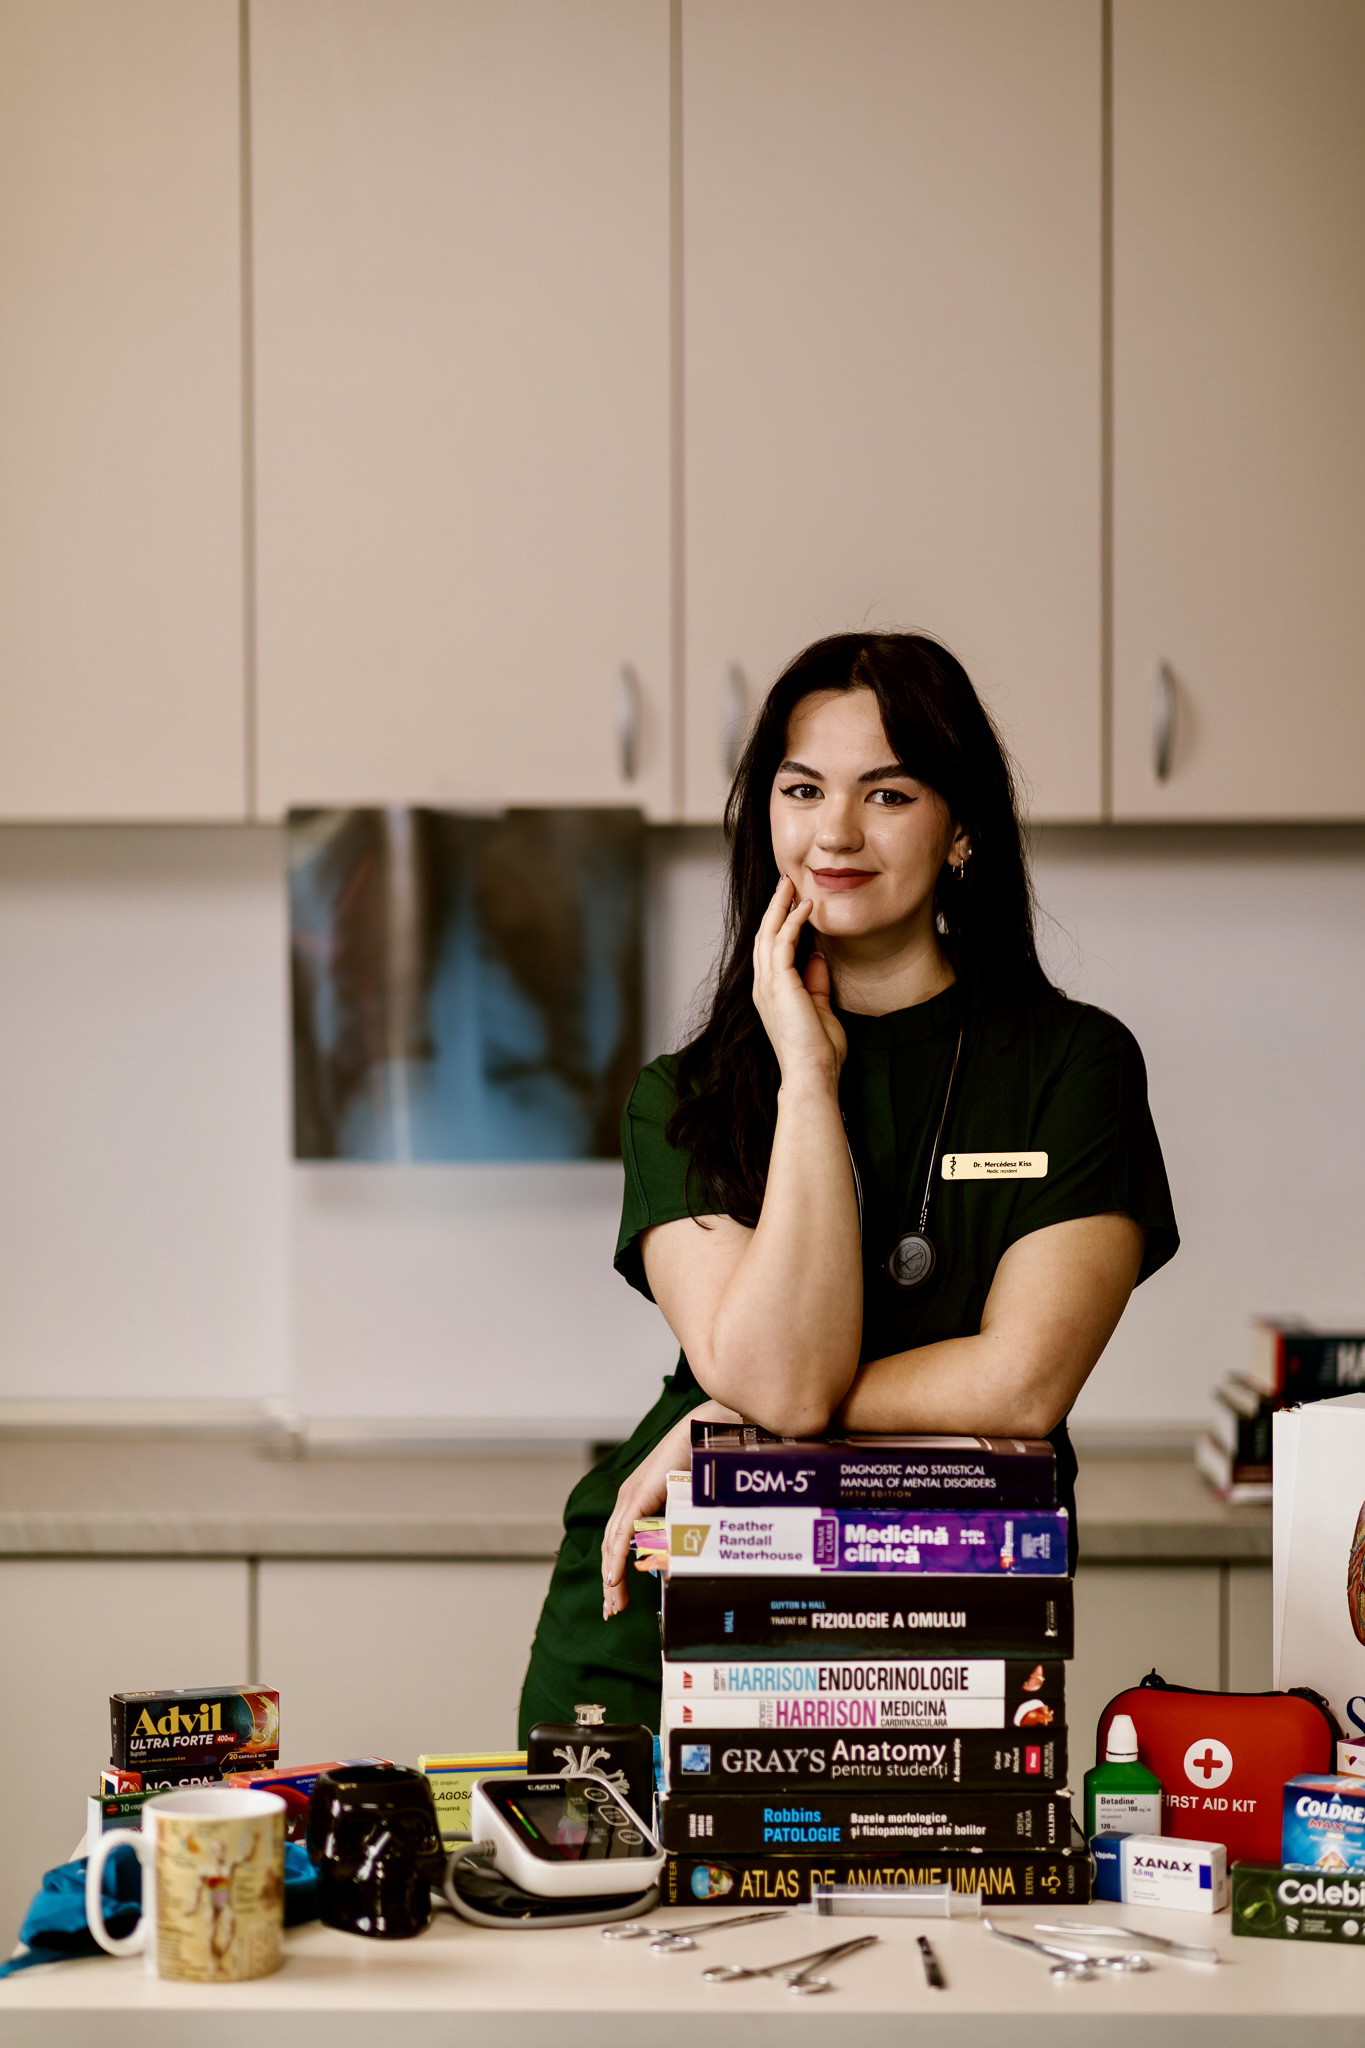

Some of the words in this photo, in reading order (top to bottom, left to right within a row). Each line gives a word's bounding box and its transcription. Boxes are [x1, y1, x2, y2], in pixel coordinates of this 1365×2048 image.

[840, 1464, 902, 1475] DIAGNOSTIC
[905, 1464, 929, 1475] AND
[930, 1464, 986, 1475] STATISTICAL
[840, 1477, 884, 1489] MANUAL
[886, 1477, 901, 1488] OF
[903, 1477, 942, 1488] MENTAL
[944, 1477, 997, 1489] DISORDERS
[840, 1490, 867, 1498] FIFTH
[871, 1490, 912, 1498] EDITION
[719, 1520, 774, 1532] Feather
[719, 1534, 772, 1546] Randall
[844, 1524, 949, 1546] Medicină
[719, 1550, 803, 1561] Waterhouse
[844, 1544, 921, 1564] clinică
[770, 1601, 800, 1610] GUYTON
[801, 1601, 807, 1610] &
[808, 1601, 826, 1609] HALL
[724, 1610, 734, 1633] HALL
[771, 1616, 796, 1626] TRATAT
[798, 1616, 807, 1625] DE
[811, 1612, 889, 1629] FIZIOLOGIE
[892, 1612, 905, 1629] A
[907, 1612, 967, 1628] OMULUI
[728, 1667, 817, 1691] HARRISON
[818, 1667, 969, 1691] ENDOCRINOLOGIE
[130, 1703, 223, 1738] Advil
[776, 1700, 876, 1727] HARRISON
[130, 1737, 170, 1750] ULTRA
[172, 1734, 214, 1747] FORTE
[831, 1739, 947, 1765] Anatomy
[721, 1748, 826, 1773] GRAY'S
[832, 1763, 881, 1779] pentru
[886, 1762, 948, 1779] studenți
[120, 1803, 130, 1812] 10
[1100, 1797, 1135, 1805] Betadine
[1202, 1797, 1229, 1811] AID
[1232, 1798, 1257, 1813] KIT
[763, 1808, 821, 1823] Robbins
[1295, 1796, 1365, 1824] COLDRE
[851, 1812, 885, 1824] Bazele
[888, 1812, 947, 1825] morfologice
[1048, 1802, 1056, 1844] CALLISTO
[764, 1827, 841, 1842] PATOLOGIE
[862, 1825, 934, 1838] fiziopatologice
[936, 1825, 951, 1836] ale
[954, 1824, 986, 1836] bolilor
[1134, 1855, 1193, 1873] XANAX
[669, 1861, 677, 1903] NETTER
[1144, 1870, 1154, 1878] mg
[740, 1868, 799, 1898] ATLAS
